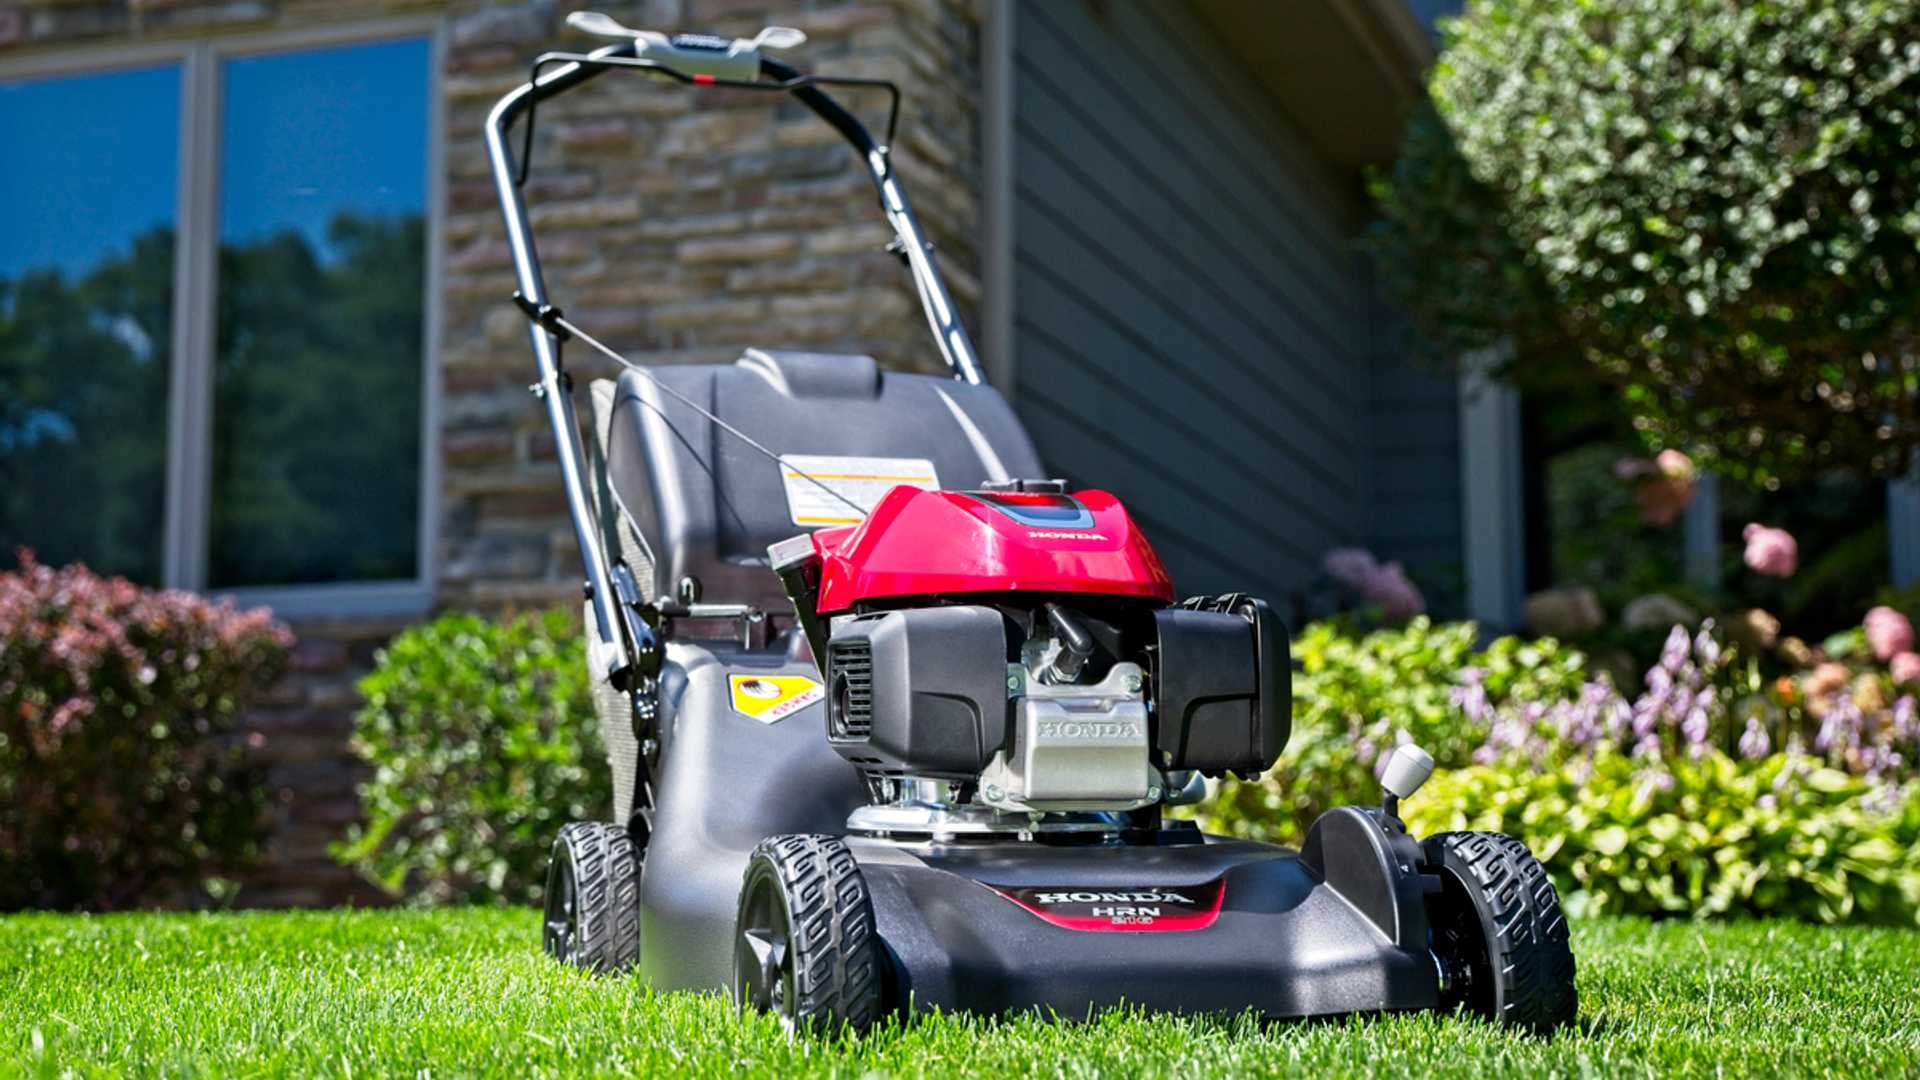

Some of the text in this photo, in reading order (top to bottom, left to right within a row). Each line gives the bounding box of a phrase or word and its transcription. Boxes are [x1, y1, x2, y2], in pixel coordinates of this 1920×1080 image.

[1026, 530, 1109, 541] HONDA
[1038, 720, 1142, 738] HONDA
[1034, 891, 1195, 904] HONDA
[1092, 906, 1161, 917] HRN
